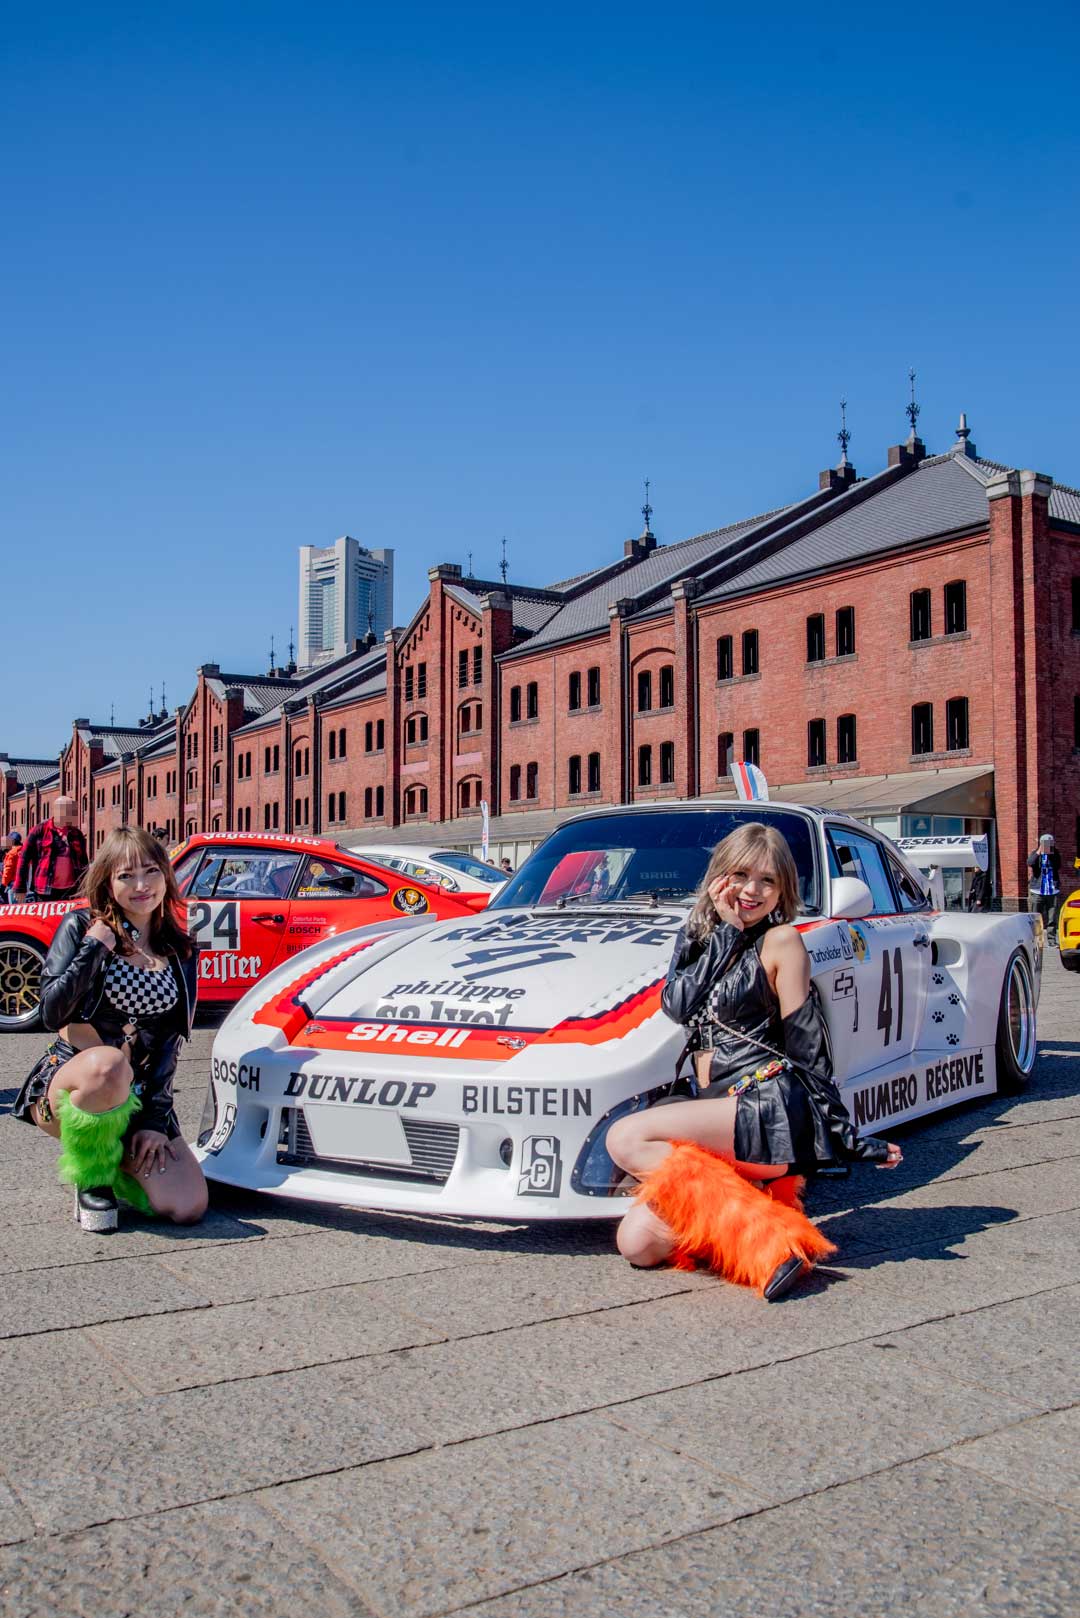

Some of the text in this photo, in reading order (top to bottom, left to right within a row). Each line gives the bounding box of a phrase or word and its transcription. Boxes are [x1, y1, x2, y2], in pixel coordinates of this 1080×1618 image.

[189, 902, 239, 950] 24
[482, 914, 683, 930] NUMERO
[381, 980, 527, 1004] philippe
[877, 946, 904, 1047] 41
[345, 1023, 473, 1049] Shell
[212, 1057, 260, 1092] BOSCH
[283, 1071, 437, 1108] DUNLOP
[853, 1048, 985, 1128] NUMERO RÉSERVÉ
[462, 1085, 592, 1116] BILSTEIN
